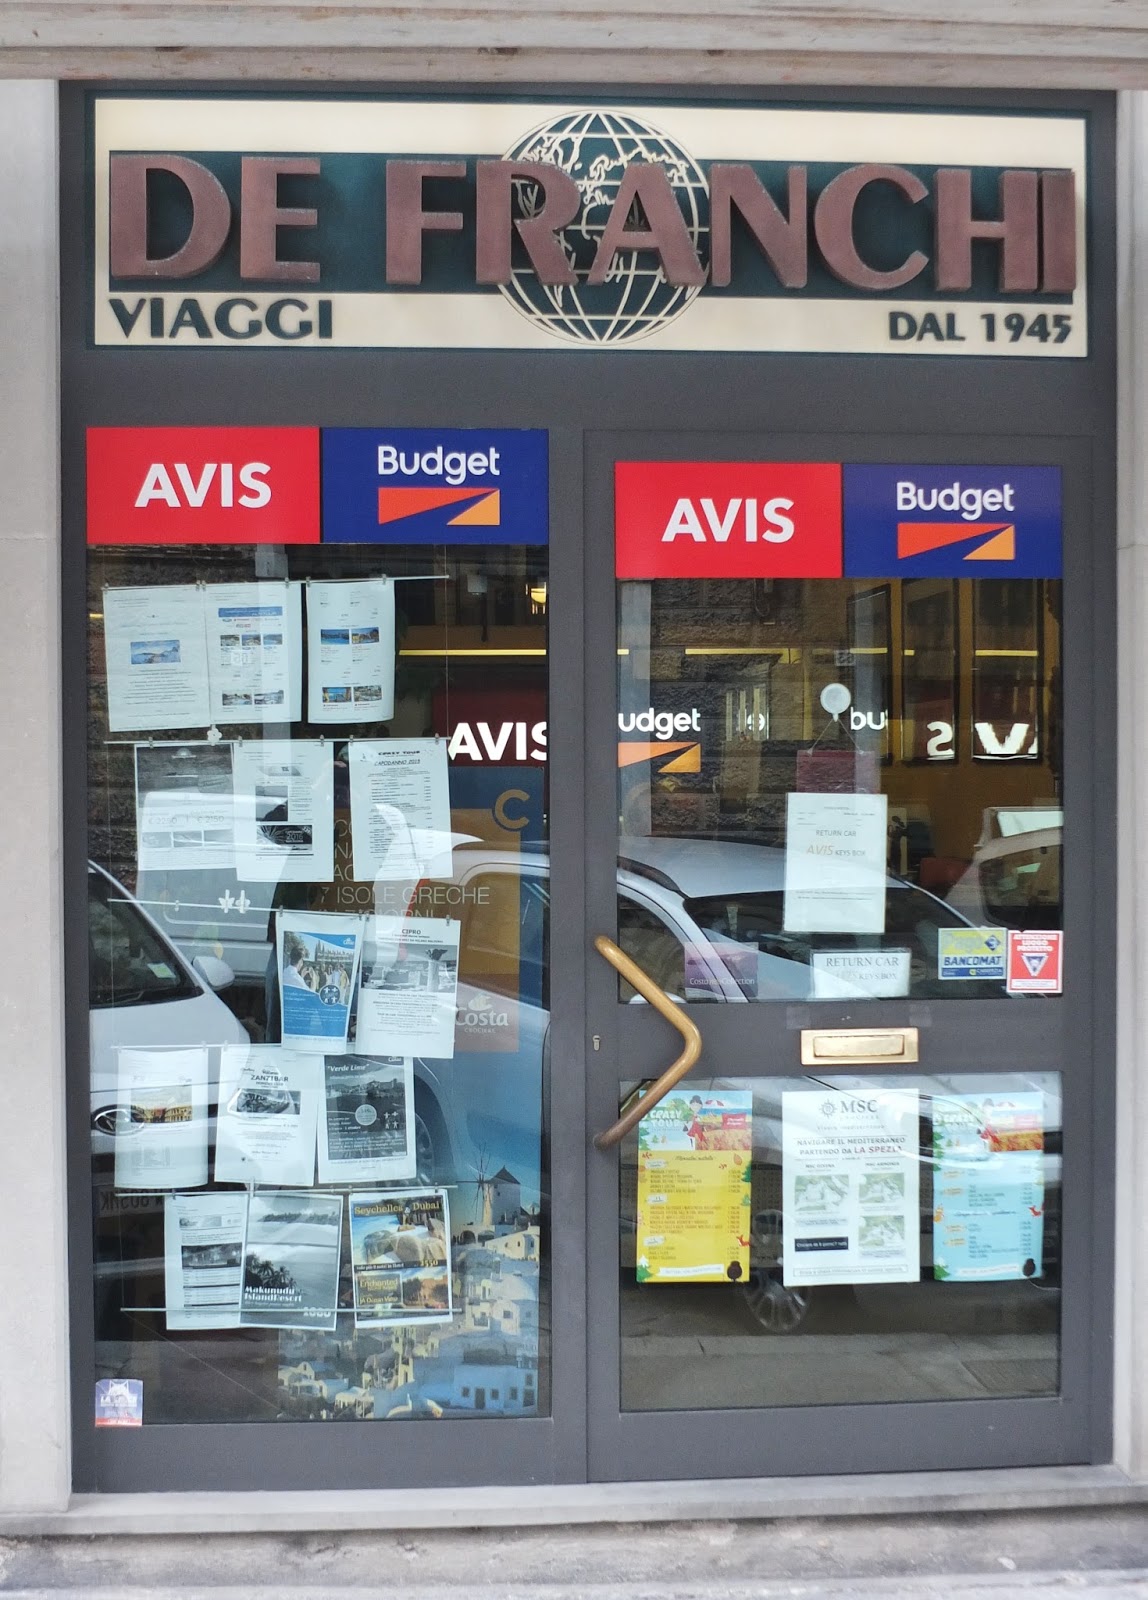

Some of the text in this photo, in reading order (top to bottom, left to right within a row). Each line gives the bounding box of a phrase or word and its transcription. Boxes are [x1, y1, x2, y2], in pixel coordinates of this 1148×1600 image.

[110, 154, 1077, 294] DE FRANCHI
[109, 298, 333, 339] VIAGGI
[888, 312, 1072, 344] DAL 1945
[378, 445, 500, 485] Budget
[134, 462, 273, 509] AVIS
[895, 481, 1015, 521] Budget
[661, 497, 796, 543] AVIS
[617, 707, 701, 740] udget
[447, 721, 548, 761] AVIS
[816, 829, 842, 837] RETURN
[806, 844, 835, 856] AVIS
[337, 886, 395, 904] ISOLE
[402, 886, 490, 904] GRECHE
[826, 956, 900, 967] RETURN CAR
[943, 956, 1002, 966] BANCOMAT
[455, 1006, 509, 1026] Costa
[649, 1110, 682, 1119] CRAZY
[840, 1099, 877, 1113] MSC
[847, 1137, 906, 1145] MEDITERRANEO
[854, 1146, 865, 1154] LA
[355, 1204, 403, 1216] Seychelles
[412, 1200, 440, 1211] Dubai
[244, 1285, 295, 1295] Makunudu
